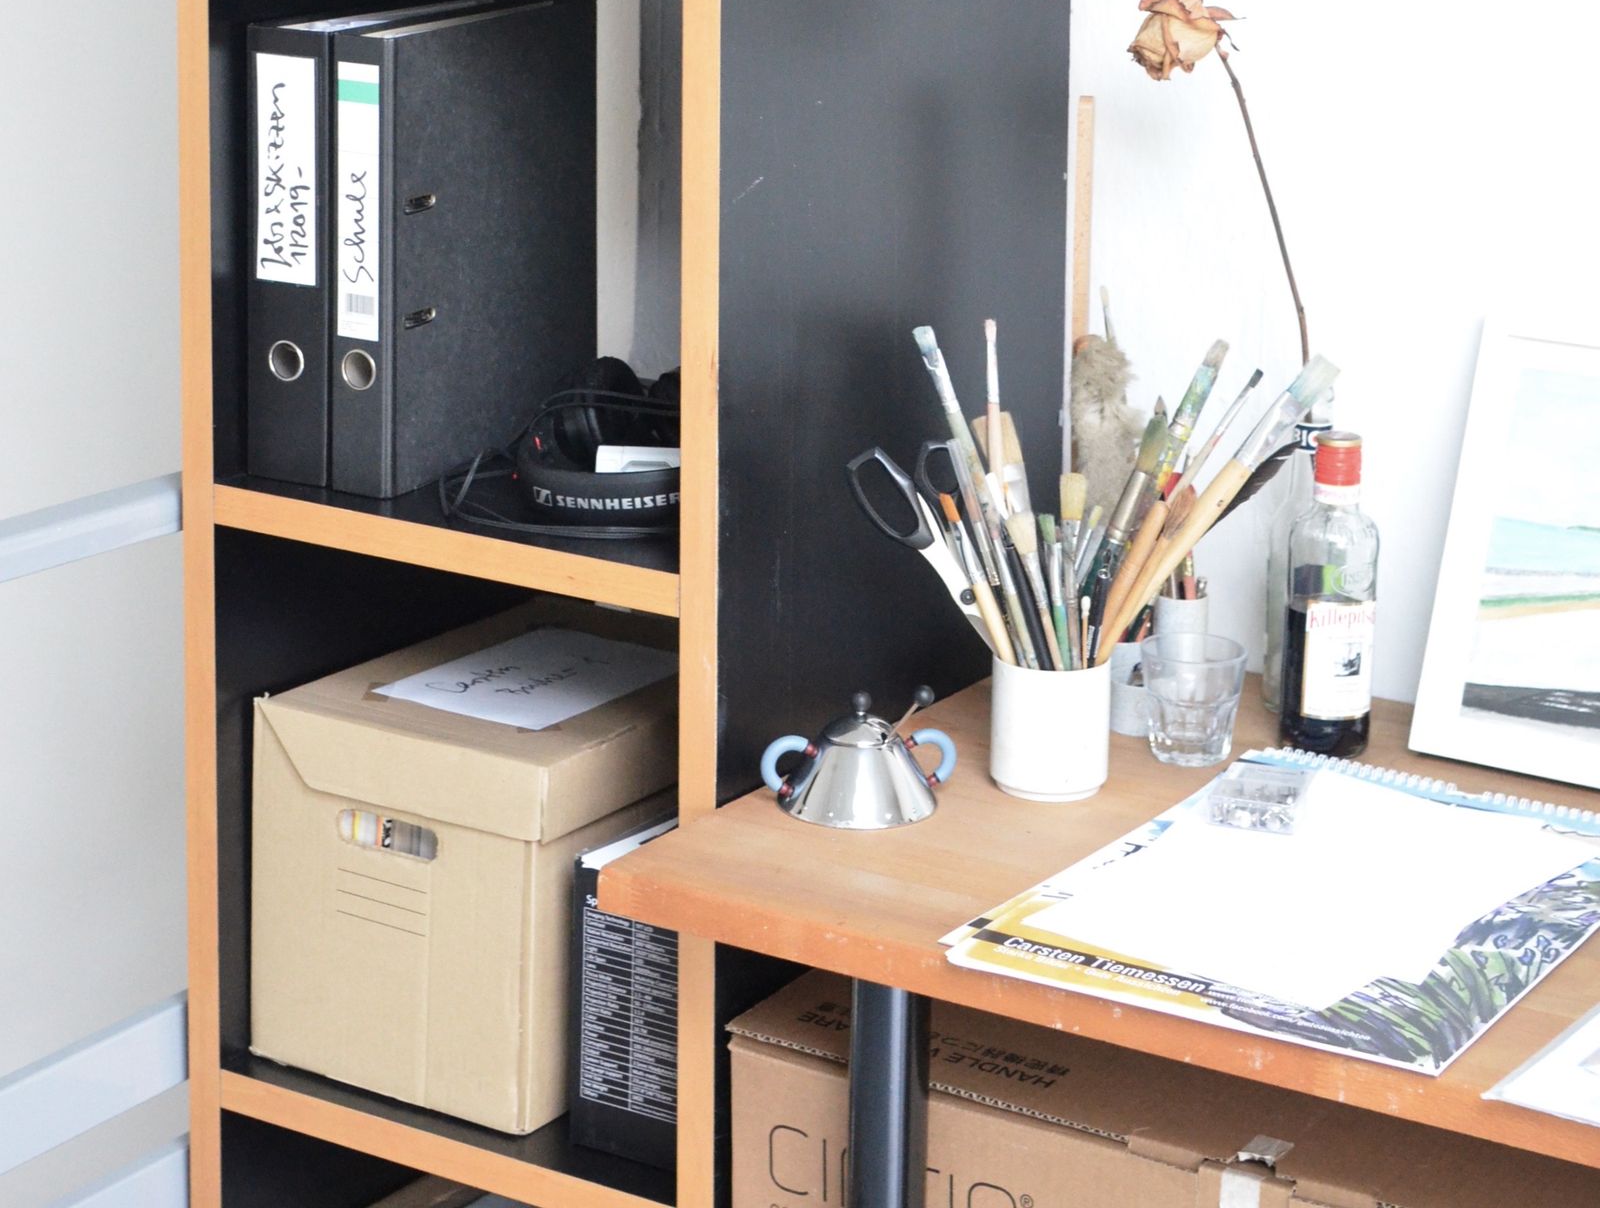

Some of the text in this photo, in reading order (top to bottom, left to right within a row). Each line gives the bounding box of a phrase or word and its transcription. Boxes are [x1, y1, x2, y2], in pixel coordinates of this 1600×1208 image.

[343, 170, 375, 283] Schule
[556, 493, 680, 511] SENNHEISER
[1003, 936, 1206, 992] Carsten Tiemessen
[796, 1011, 1056, 1088] HANDLE ARE
